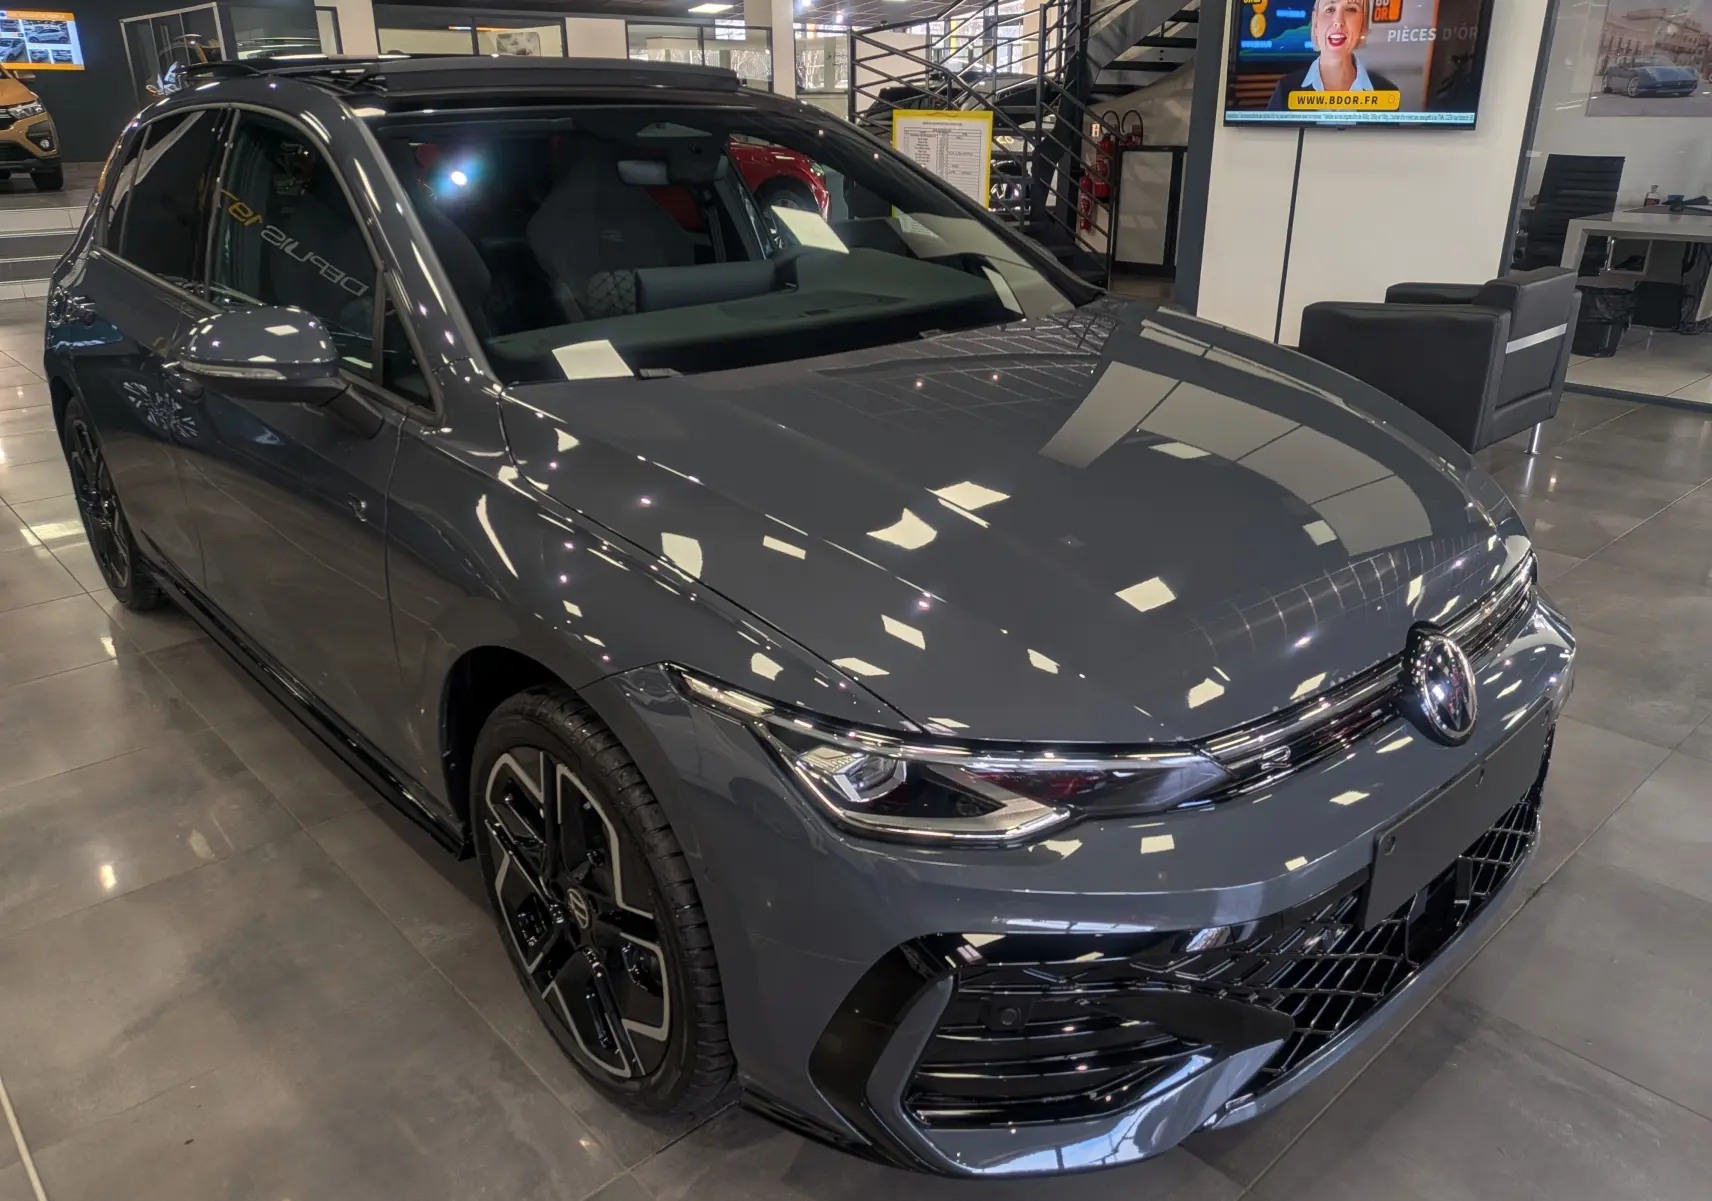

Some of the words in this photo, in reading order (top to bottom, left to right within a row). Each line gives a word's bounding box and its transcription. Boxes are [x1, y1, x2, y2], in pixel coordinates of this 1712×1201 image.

[1374, 7, 1388, 20] OR
[1388, 25, 1436, 42] PIÈCES
[1297, 95, 1378, 105] WWW.BDOR.FR
